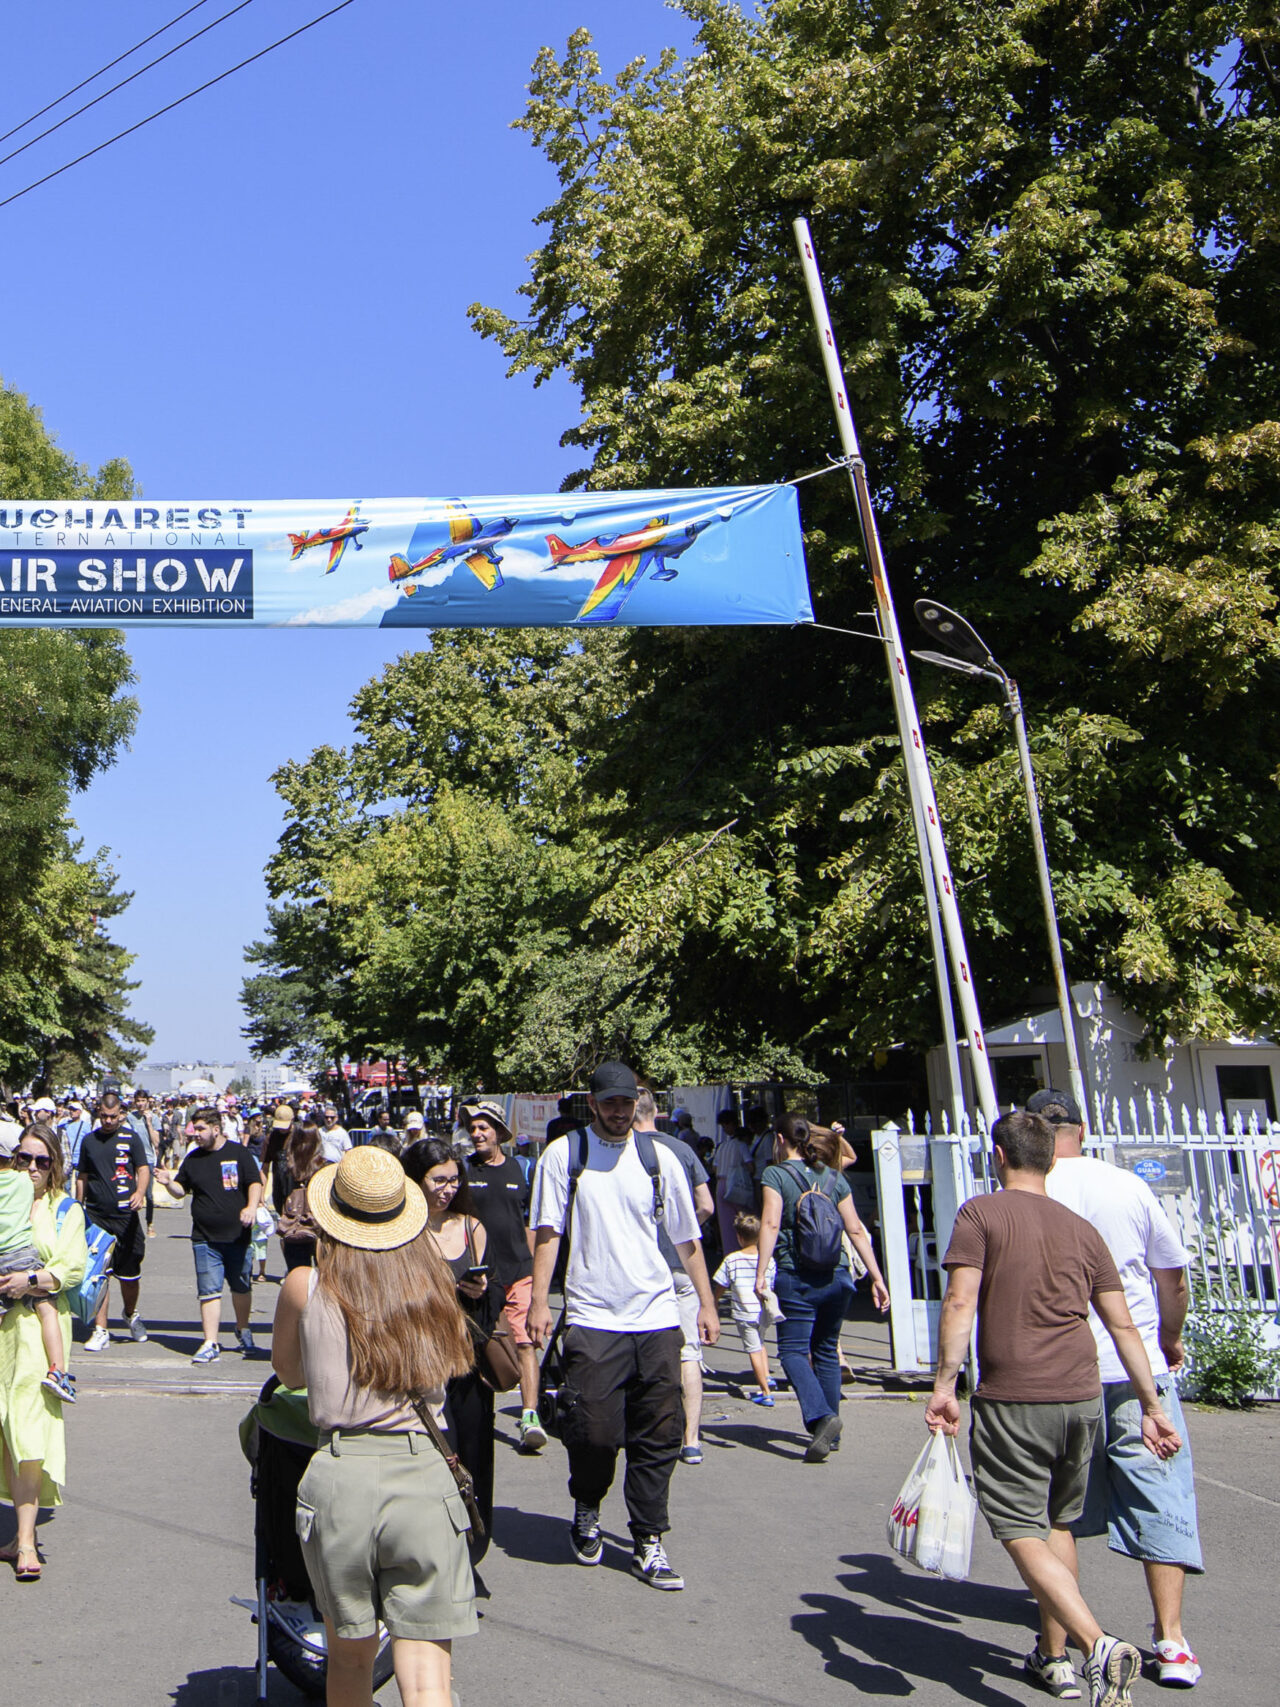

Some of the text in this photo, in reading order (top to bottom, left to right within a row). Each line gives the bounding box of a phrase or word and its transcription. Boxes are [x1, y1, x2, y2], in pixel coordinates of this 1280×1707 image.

[77, 558, 244, 592] SHOW
[70, 598, 143, 613] AVIATION
[153, 598, 245, 613] EXHIBITION
